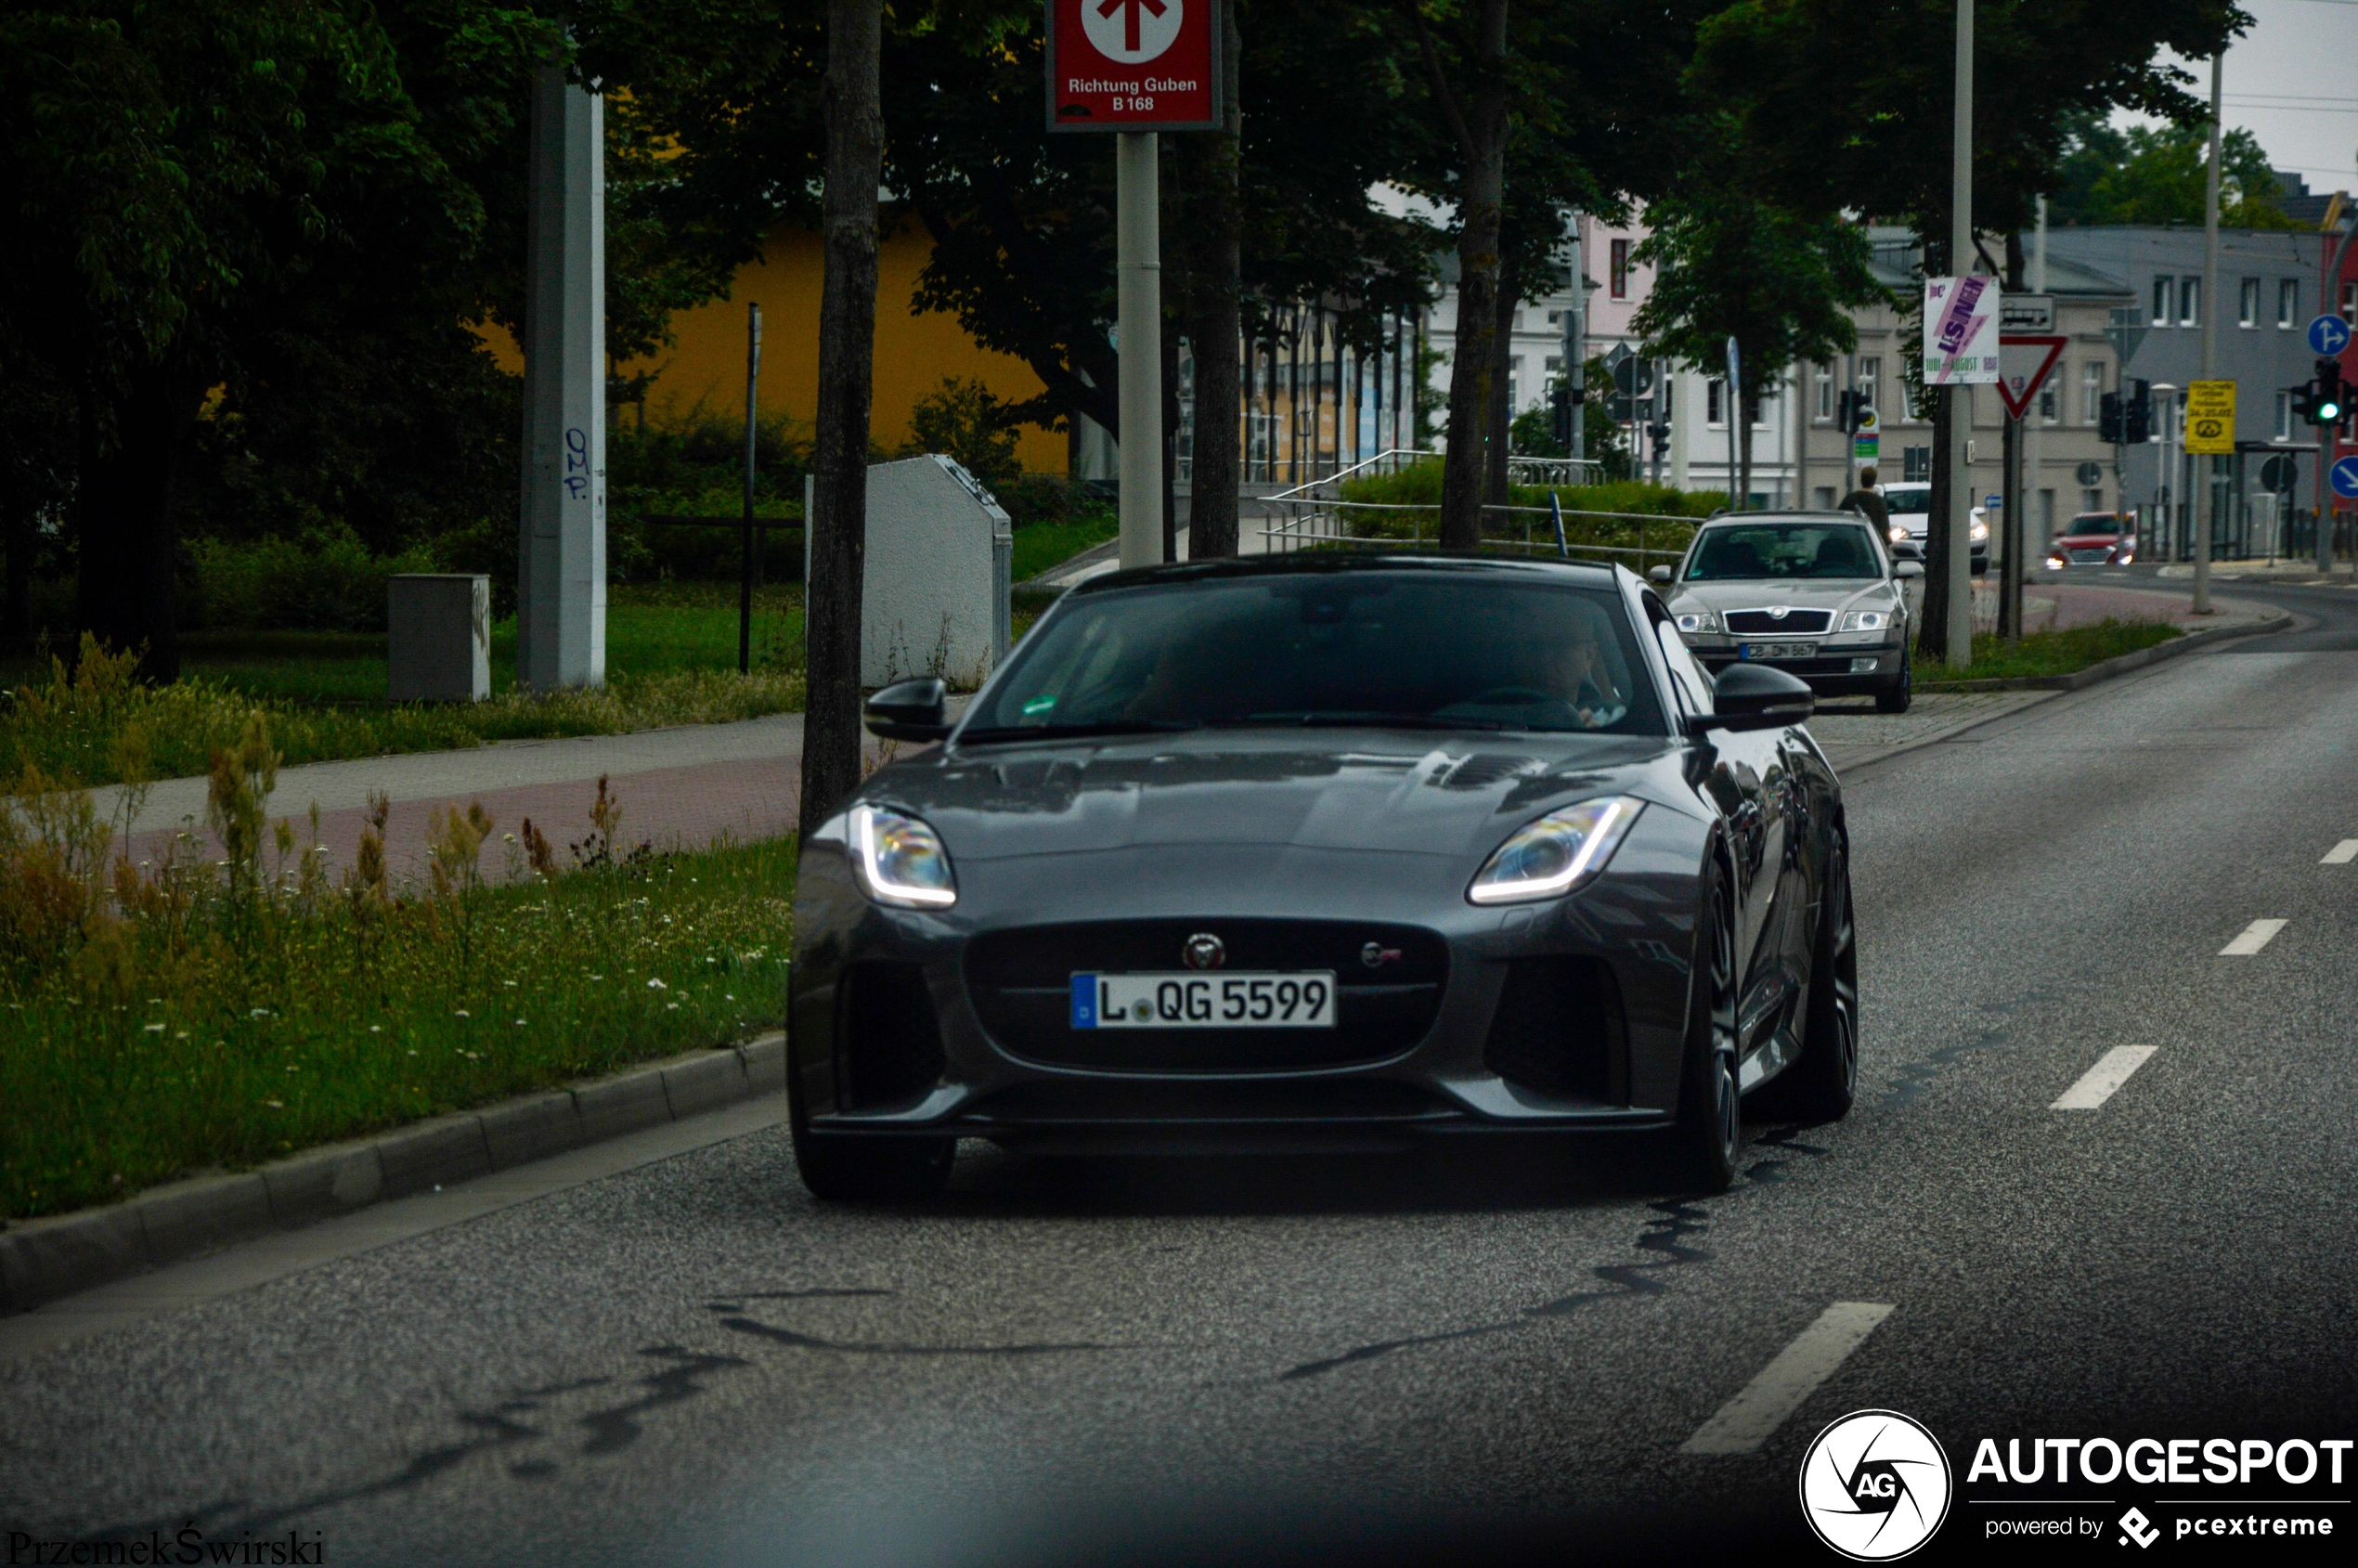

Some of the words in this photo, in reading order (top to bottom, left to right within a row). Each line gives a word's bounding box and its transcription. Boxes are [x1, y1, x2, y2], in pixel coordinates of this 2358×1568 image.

[1069, 78, 1140, 95] Richtung
[1144, 77, 1198, 92] Guben
[1113, 97, 1123, 111] B
[1127, 97, 1154, 110] 168
[1951, 356, 1977, 372] AUGUST
[1101, 981, 1127, 1021] L
[1157, 981, 1211, 1022] QG
[1223, 980, 1328, 1021] 5599
